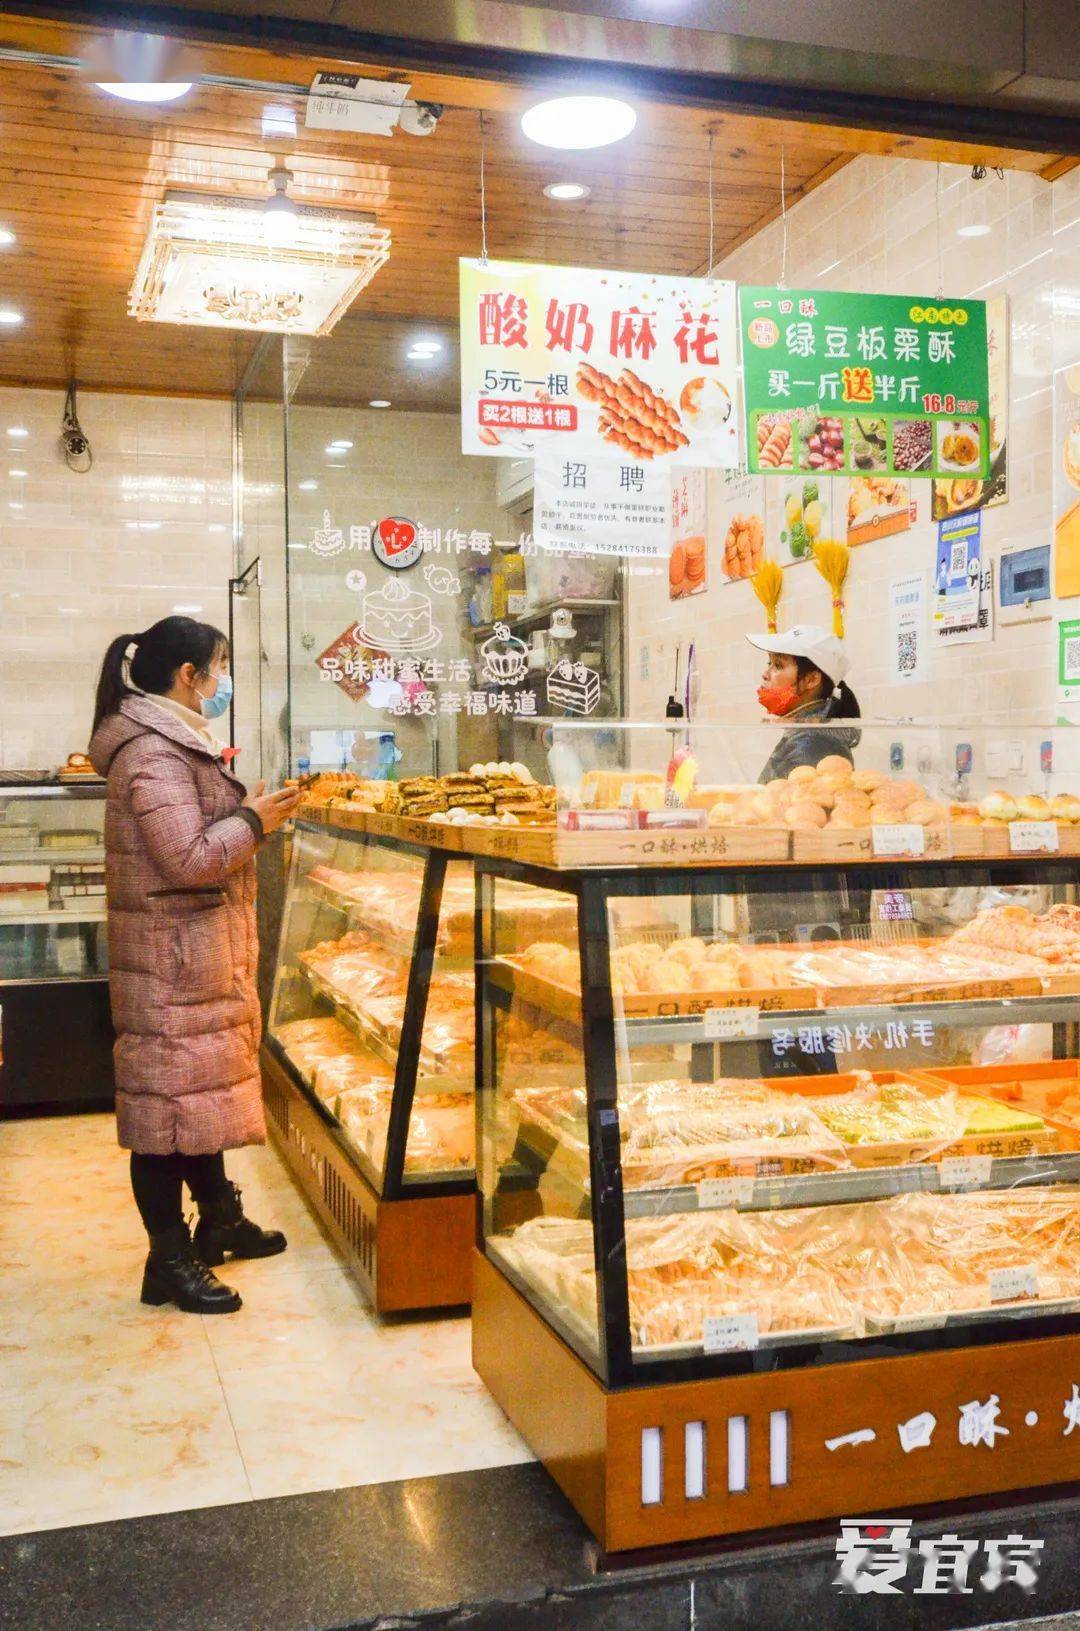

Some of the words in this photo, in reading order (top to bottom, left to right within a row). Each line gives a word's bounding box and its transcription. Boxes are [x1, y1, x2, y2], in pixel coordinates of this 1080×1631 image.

[753, 297, 819, 318] 一口酥
[479, 291, 720, 366] 酸奶麻花
[785, 321, 956, 364] 绿豆板栗酥
[484, 369, 570, 397] 5元一根
[767, 366, 921, 404] 买一斤送半斤
[562, 461, 645, 493] 招聘
[319, 656, 474, 685] 品味甜蜜生活
[388, 690, 538, 717] 感受幸福味道
